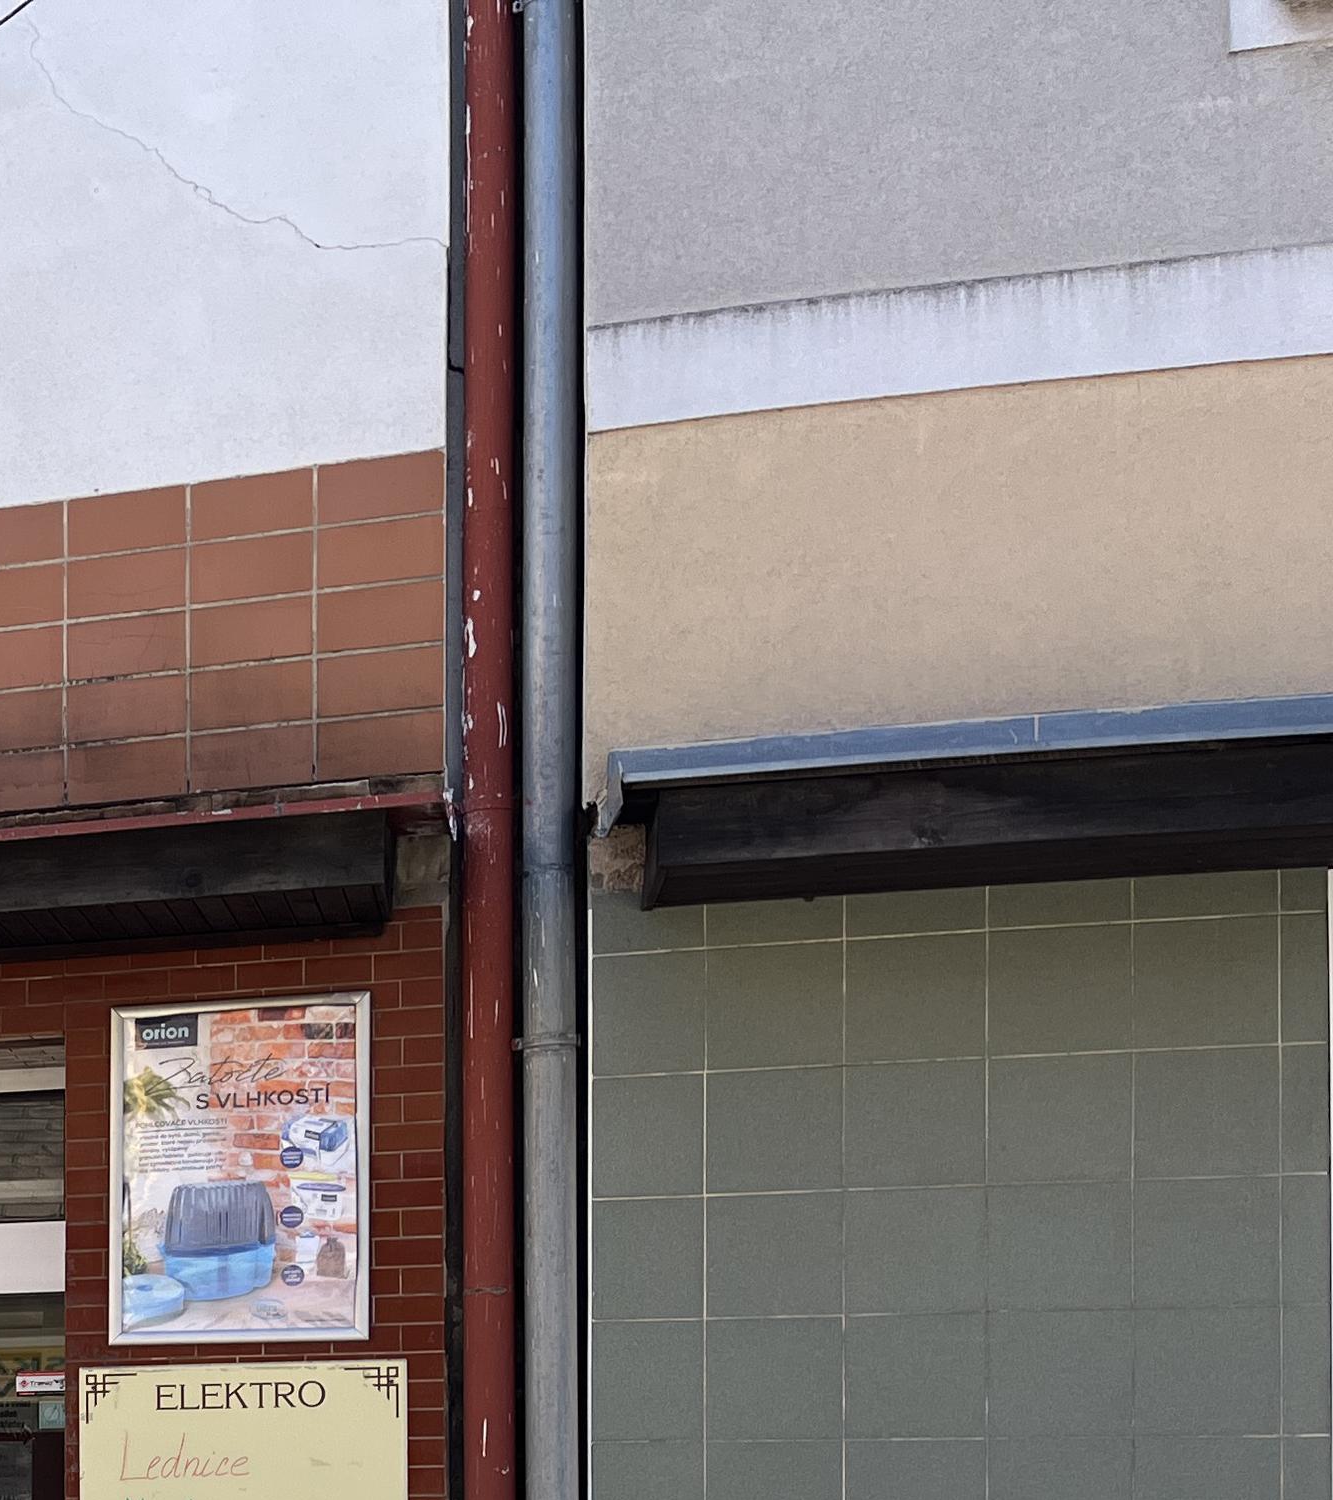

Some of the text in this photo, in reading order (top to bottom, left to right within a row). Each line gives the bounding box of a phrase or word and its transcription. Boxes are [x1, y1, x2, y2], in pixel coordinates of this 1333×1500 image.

[142, 1024, 190, 1041] orion
[196, 1083, 331, 1110] S VLHKOSTÍ
[155, 1381, 326, 1411] ELEKTRO
[119, 1429, 251, 1481] Lednice
